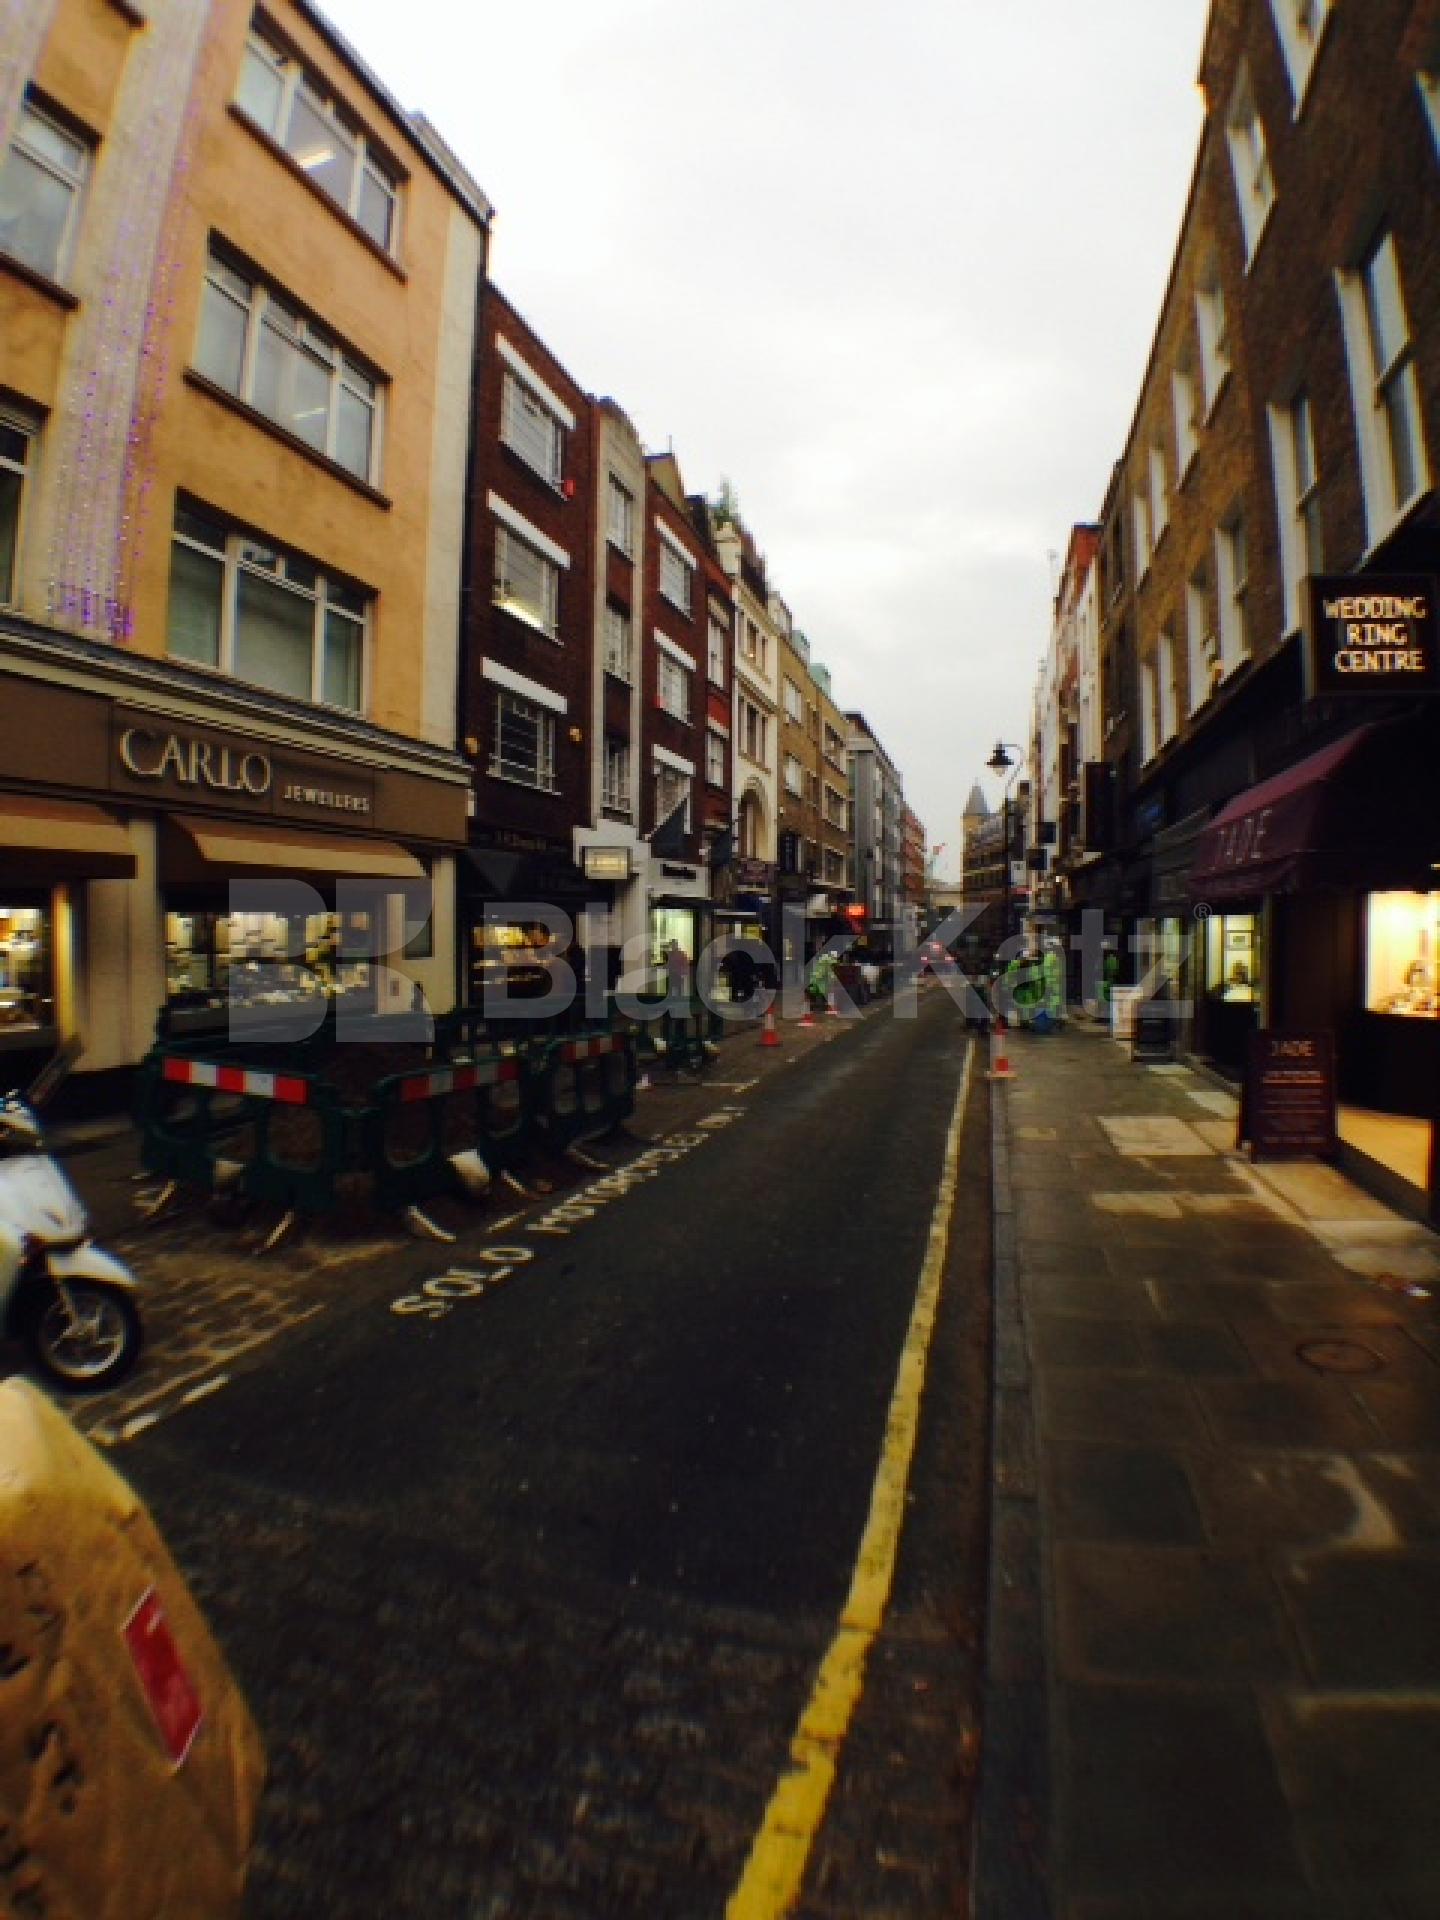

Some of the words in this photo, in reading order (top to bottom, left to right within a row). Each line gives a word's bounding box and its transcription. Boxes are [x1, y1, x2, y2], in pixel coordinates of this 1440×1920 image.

[1323, 596, 1426, 619] WEDDING
[1346, 623, 1408, 646] RING
[1334, 650, 1425, 673] CENTRE
[119, 728, 271, 794] CARLO
[284, 784, 370, 814] JEWELLERS
[390, 1246, 534, 1319] SOLO
